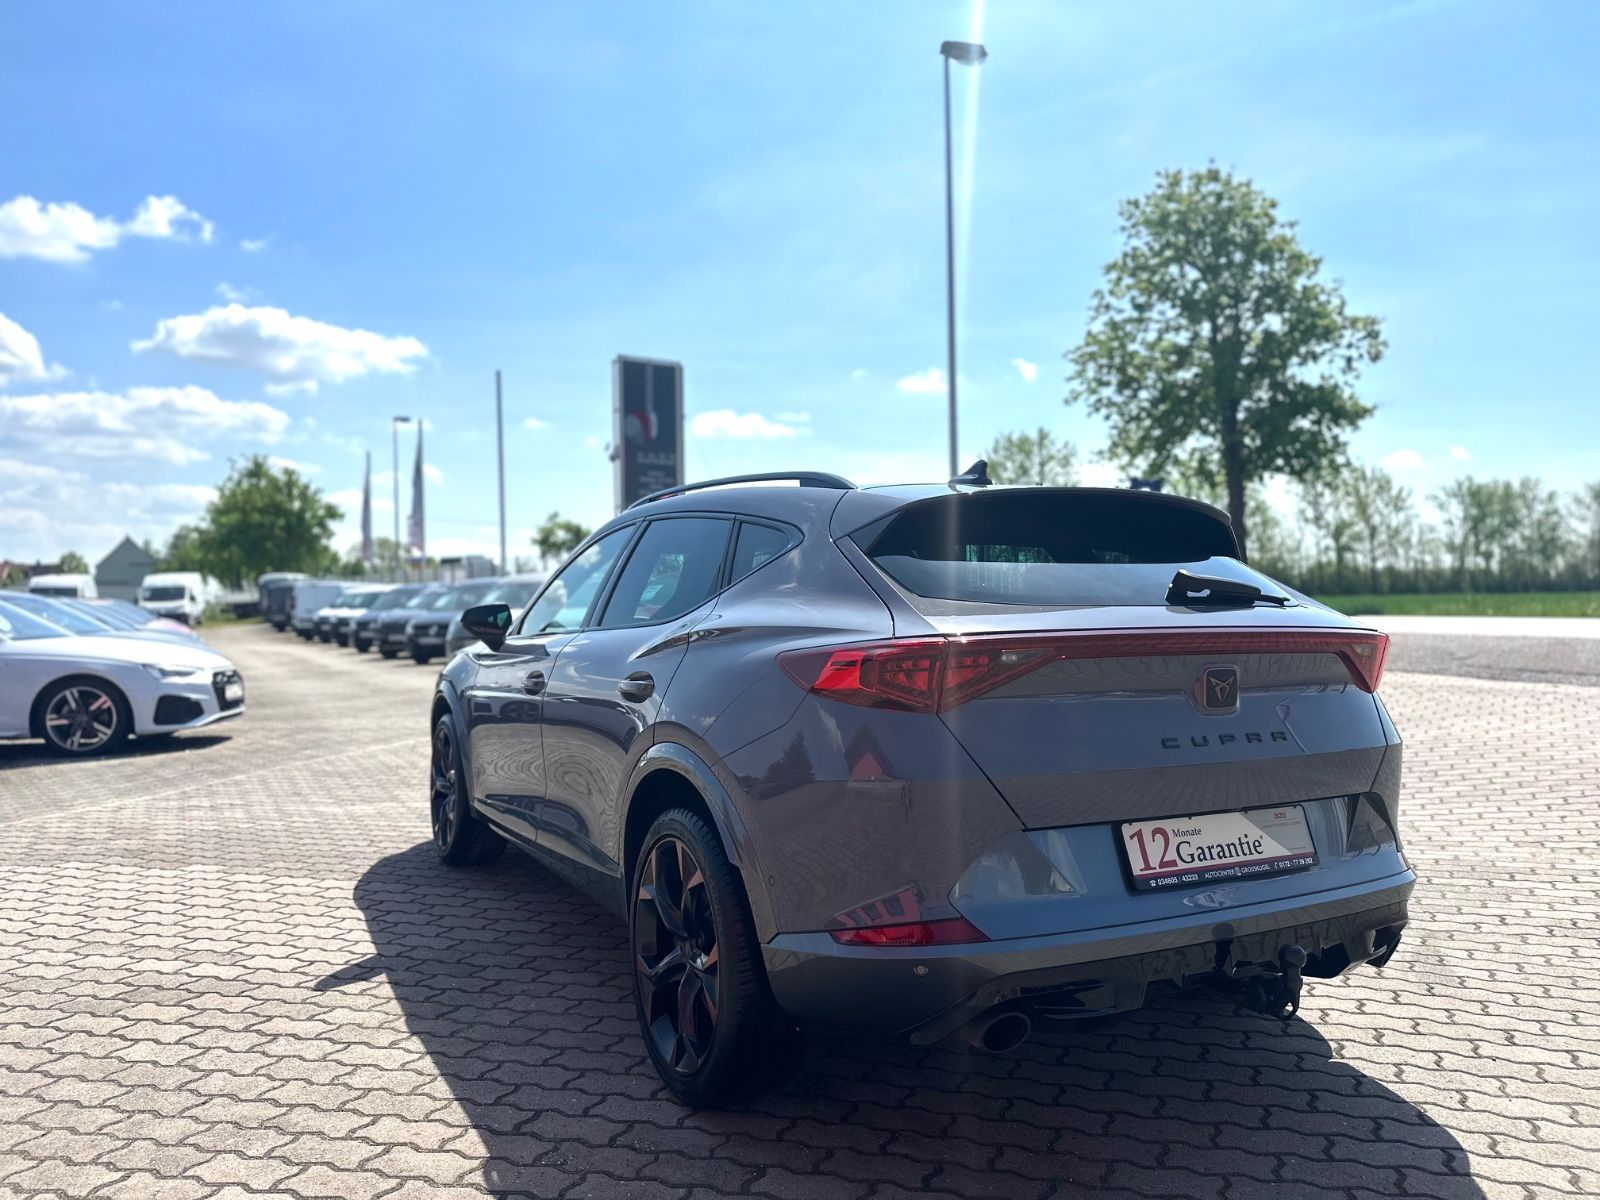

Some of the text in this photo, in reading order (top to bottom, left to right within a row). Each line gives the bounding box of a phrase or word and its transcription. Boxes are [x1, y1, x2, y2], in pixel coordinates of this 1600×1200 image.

[1160, 730, 1288, 750] CUPRA
[1172, 827, 1202, 838] Monate
[1129, 826, 1178, 872] 12
[1205, 863, 1271, 879] AUTOCENTER GROSSKUGEL
